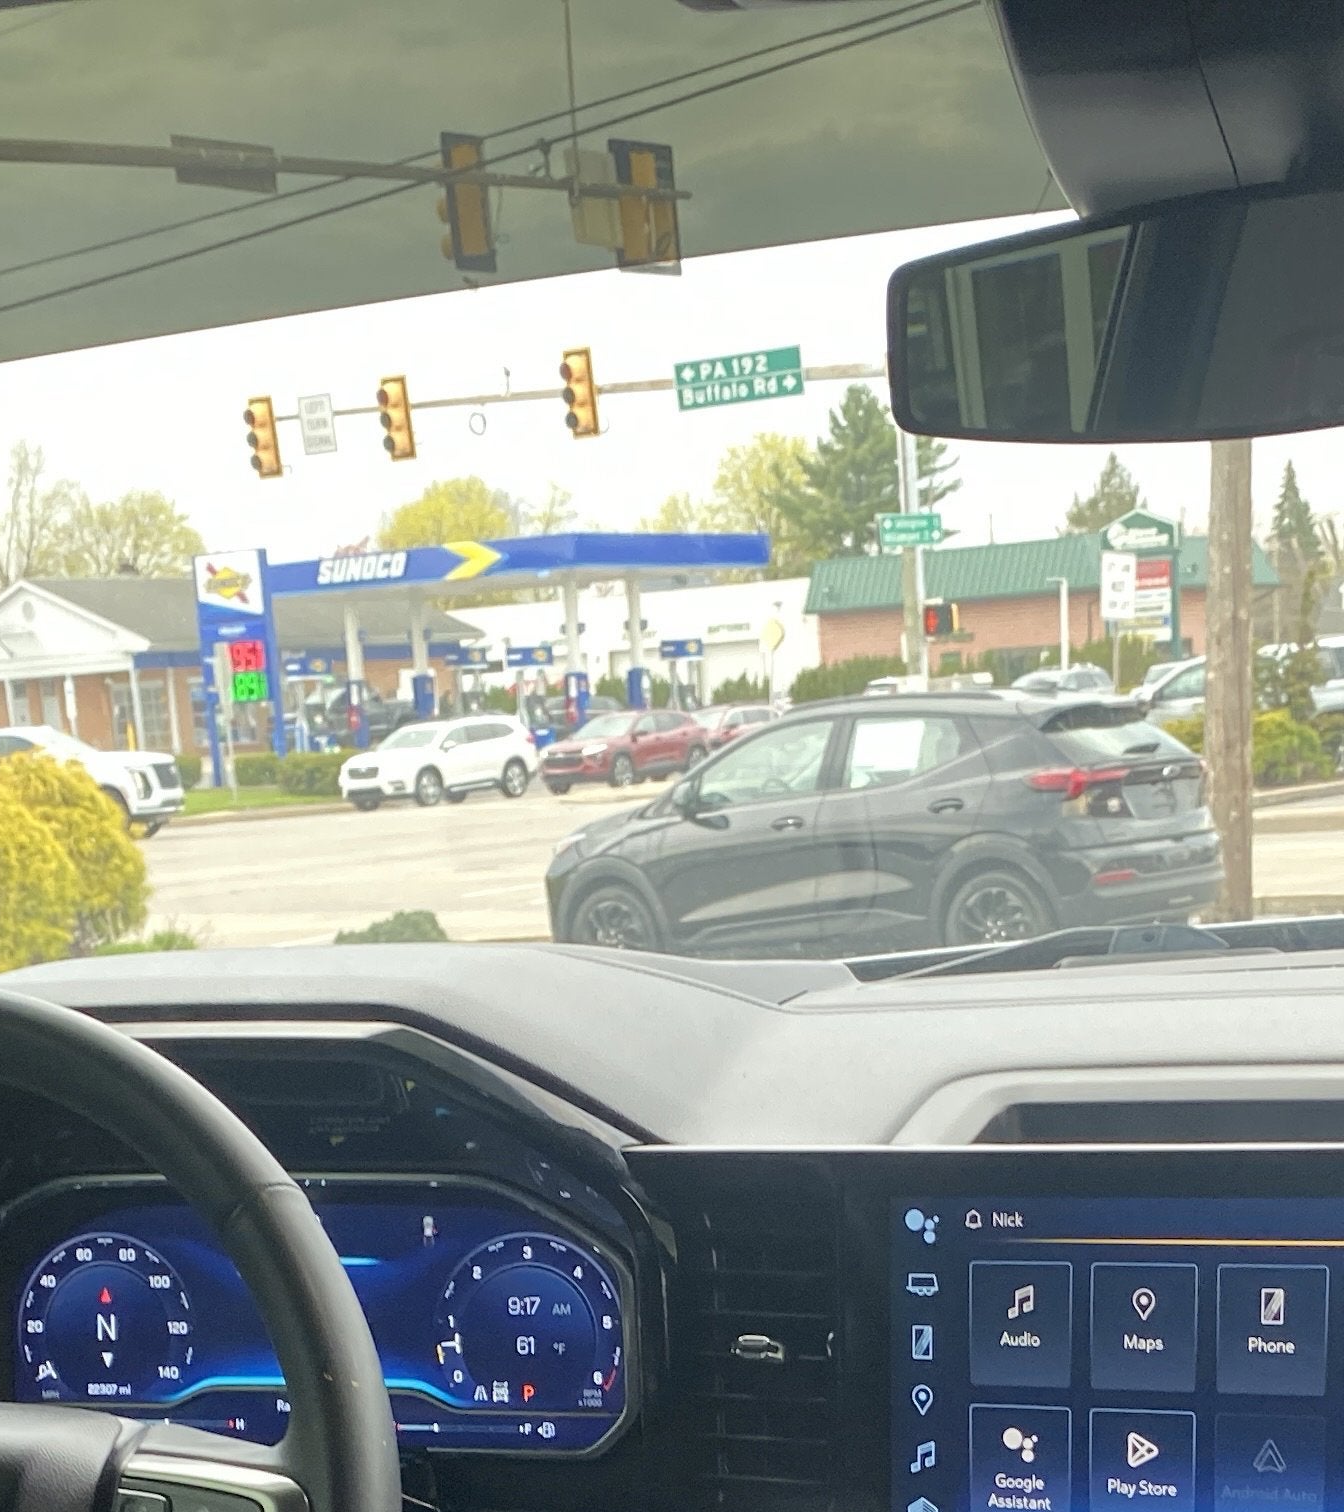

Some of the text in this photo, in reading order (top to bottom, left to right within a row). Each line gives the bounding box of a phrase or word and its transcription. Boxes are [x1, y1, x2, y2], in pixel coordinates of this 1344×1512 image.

[699, 354, 768, 381] PA 192
[682, 376, 778, 406] Buffalo Rd
[317, 552, 407, 585] SUNOCO
[992, 1211, 1024, 1229] Nick
[522, 1245, 533, 1260] 3
[39, 1275, 57, 1288] 40
[472, 1265, 483, 1280] 2
[573, 1265, 584, 1280] 4
[149, 1275, 171, 1289] 100
[508, 1296, 541, 1316] 9:17
[552, 1303, 572, 1316] AM
[26, 1319, 44, 1334] 20
[96, 1312, 116, 1342] N
[167, 1321, 188, 1335] 120
[516, 1336, 536, 1356] 61
[999, 1330, 1041, 1348] Audio
[1123, 1333, 1165, 1354] Maps
[1247, 1336, 1296, 1355] Phone
[158, 1365, 179, 1379] 140
[521, 1383, 536, 1403] P
[994, 1472, 1045, 1493] Google
[1107, 1478, 1178, 1498] Play Store
[987, 1493, 1052, 1511] Assistant
